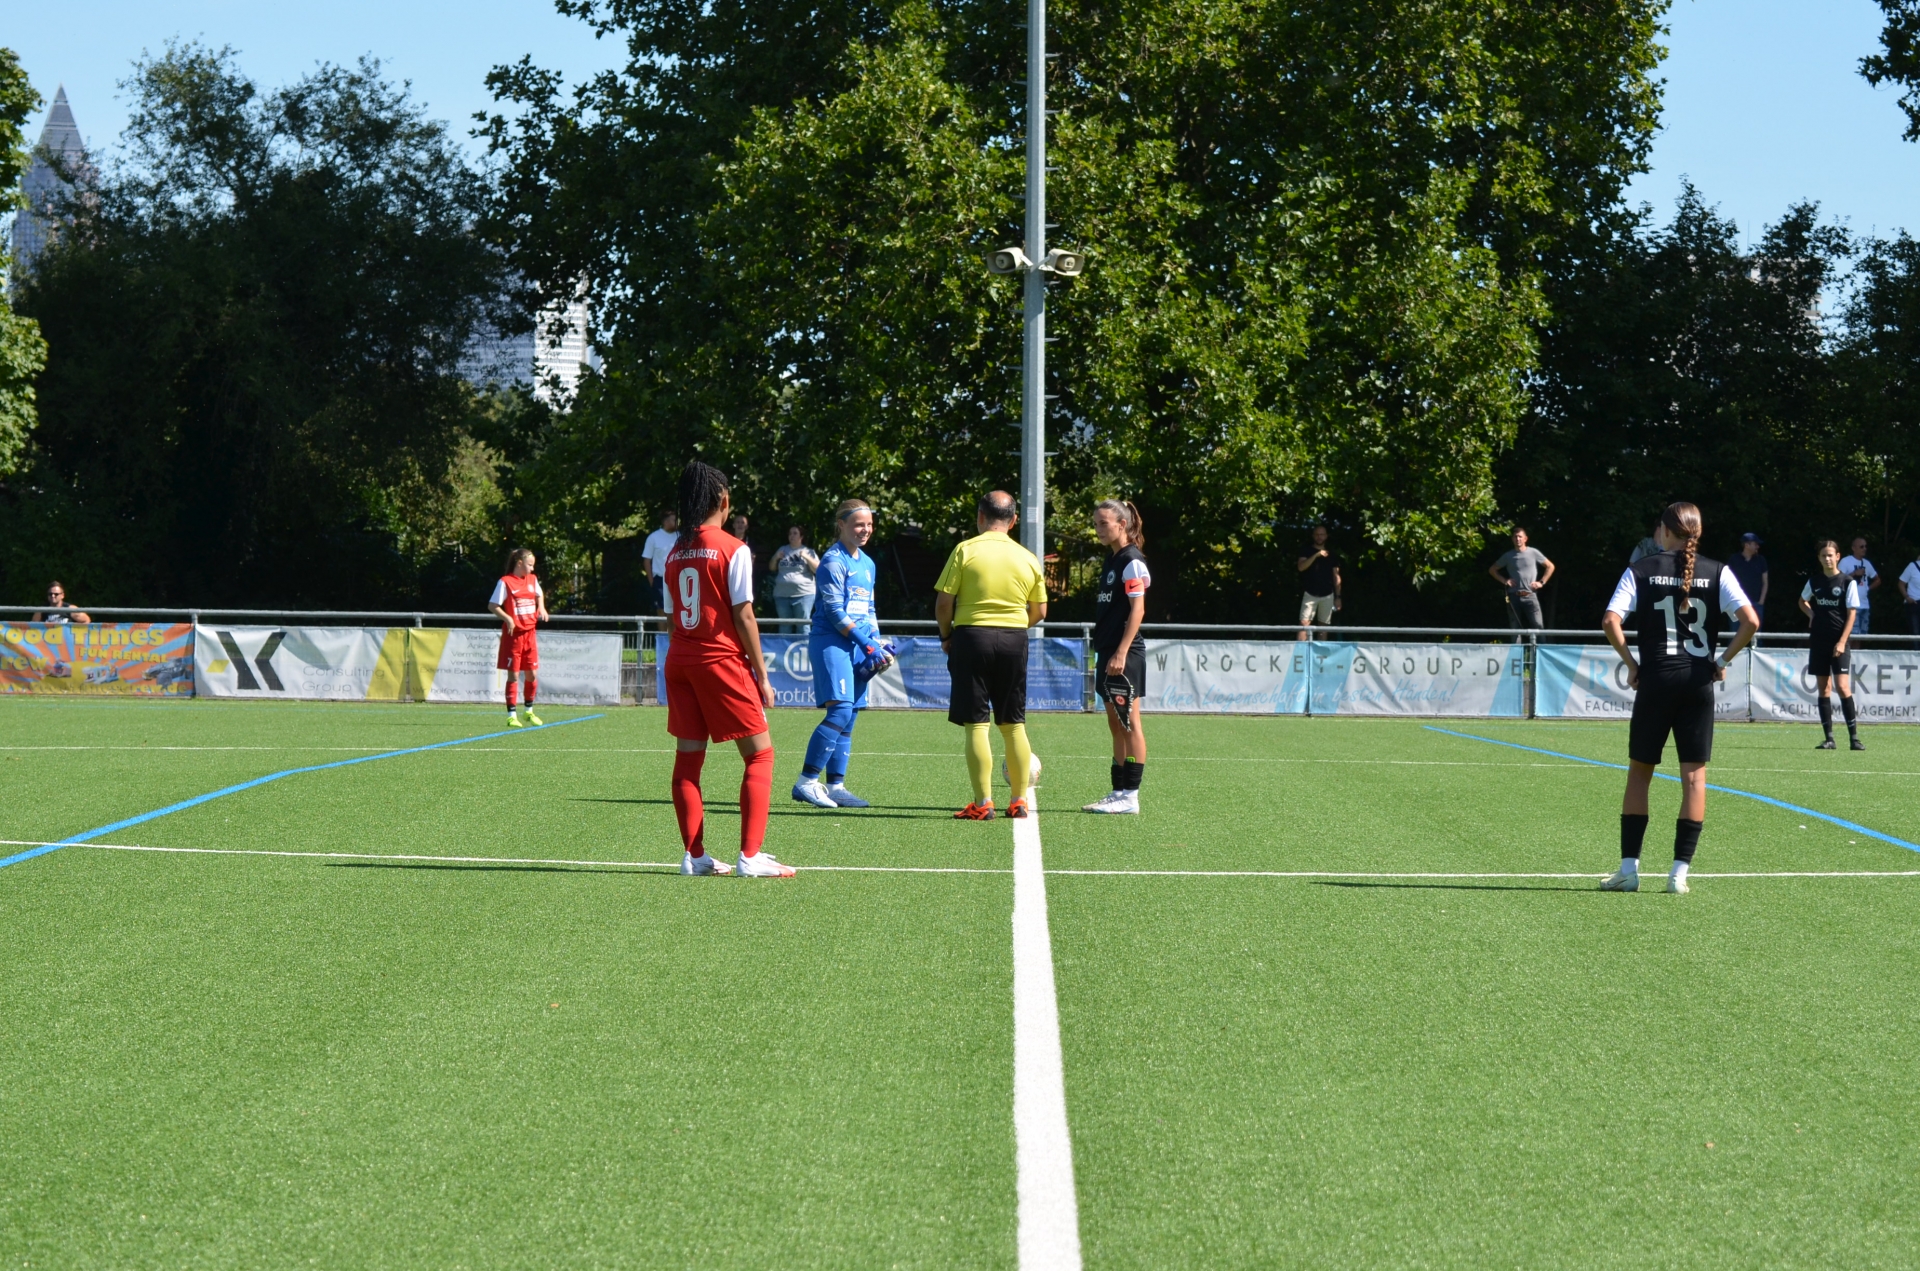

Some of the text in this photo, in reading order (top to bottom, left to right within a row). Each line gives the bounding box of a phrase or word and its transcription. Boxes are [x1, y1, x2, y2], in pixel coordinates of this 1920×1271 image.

[679, 567, 699, 629] 9
[1654, 595, 1709, 657] 13
[0, 624, 165, 646] ood Times
[80, 647, 168, 663] FUN RENTAL
[507, 658, 513, 667] 7
[1, 656, 48, 671] rew
[303, 667, 385, 679] Consulting
[1775, 662, 1918, 696] ROKET
[302, 681, 352, 693] Group
[840, 679, 846, 694] 1
